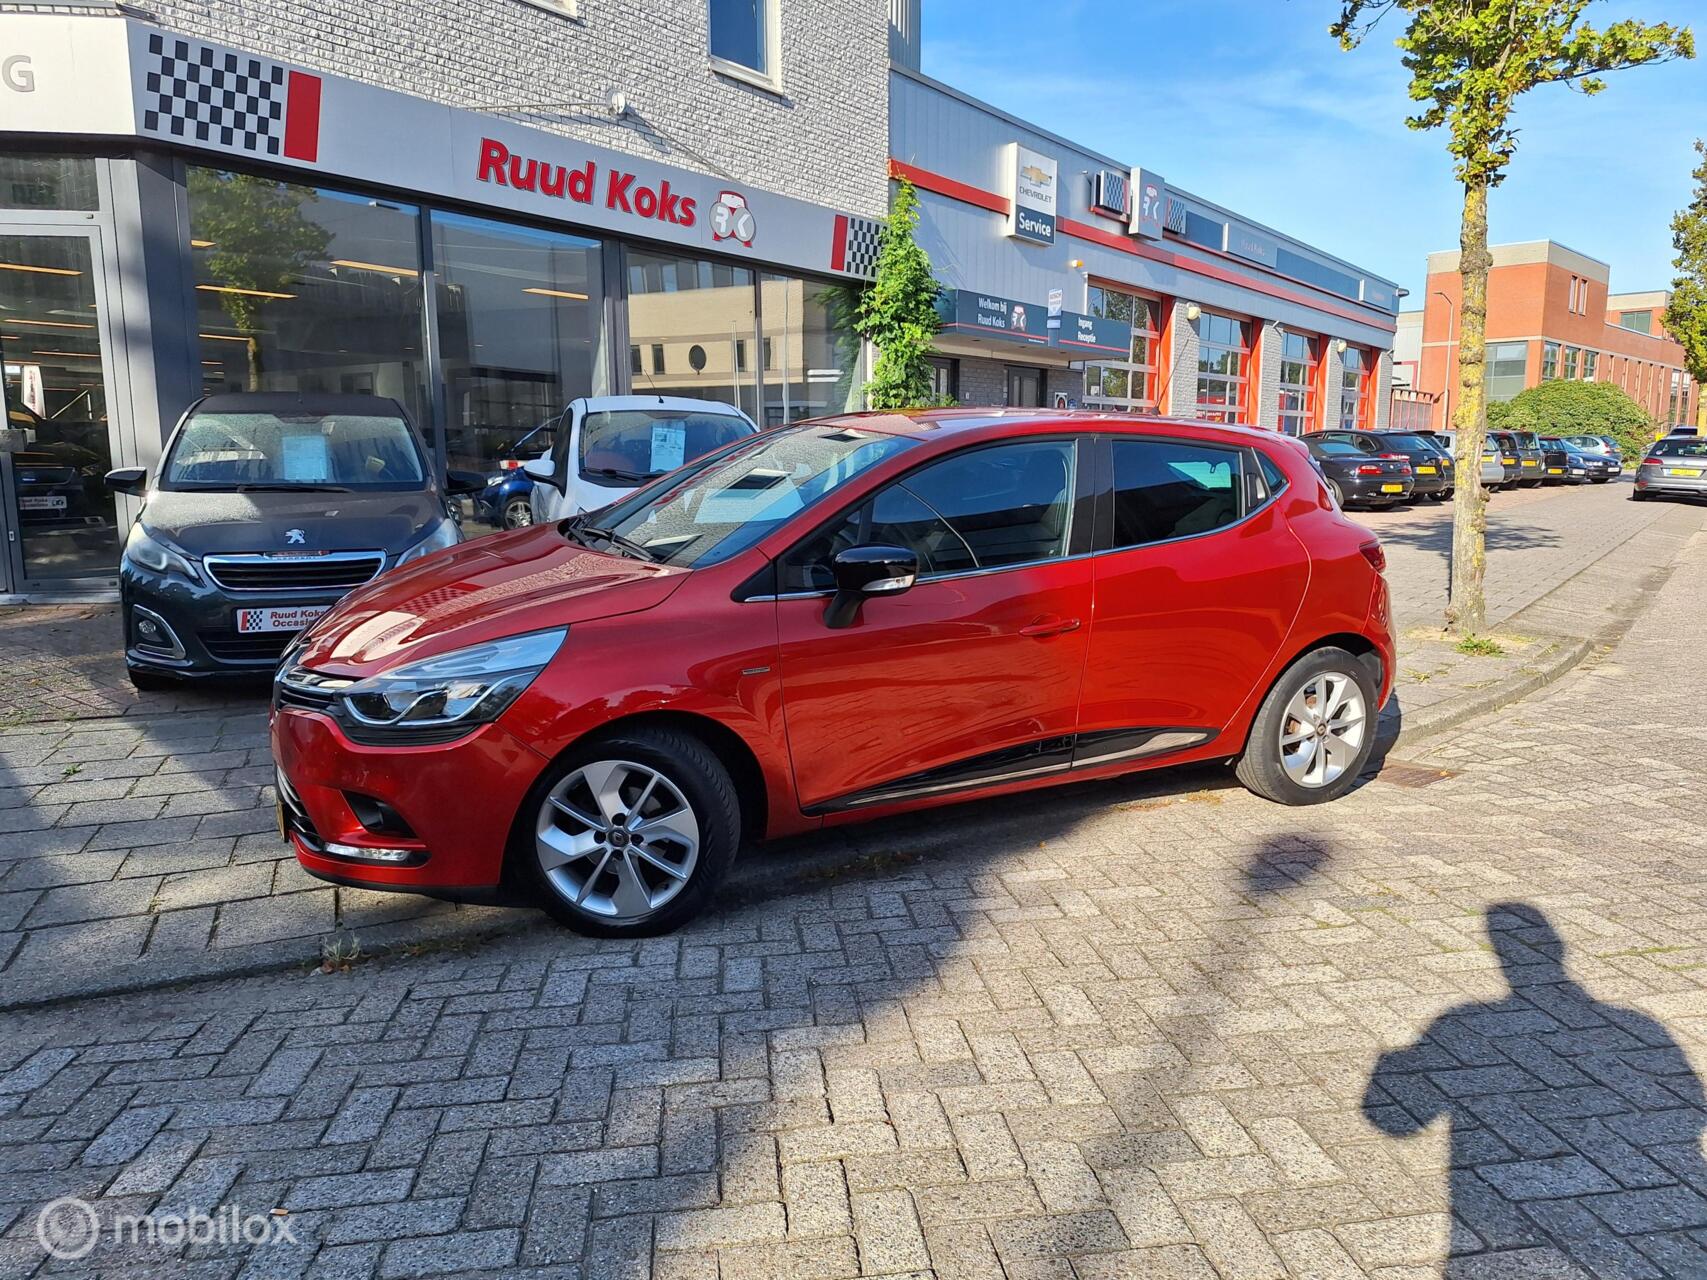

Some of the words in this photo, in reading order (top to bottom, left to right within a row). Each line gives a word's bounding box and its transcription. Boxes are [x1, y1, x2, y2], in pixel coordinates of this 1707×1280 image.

[476, 137, 597, 204] Ruud
[605, 169, 697, 227] Koks
[1019, 186, 1052, 203] CHEVROLET
[1018, 211, 1051, 237] Service
[978, 297, 1000, 311] Welkom
[977, 313, 992, 326] Ruud
[992, 315, 1006, 328] Koks
[270, 610, 297, 619] Ruud
